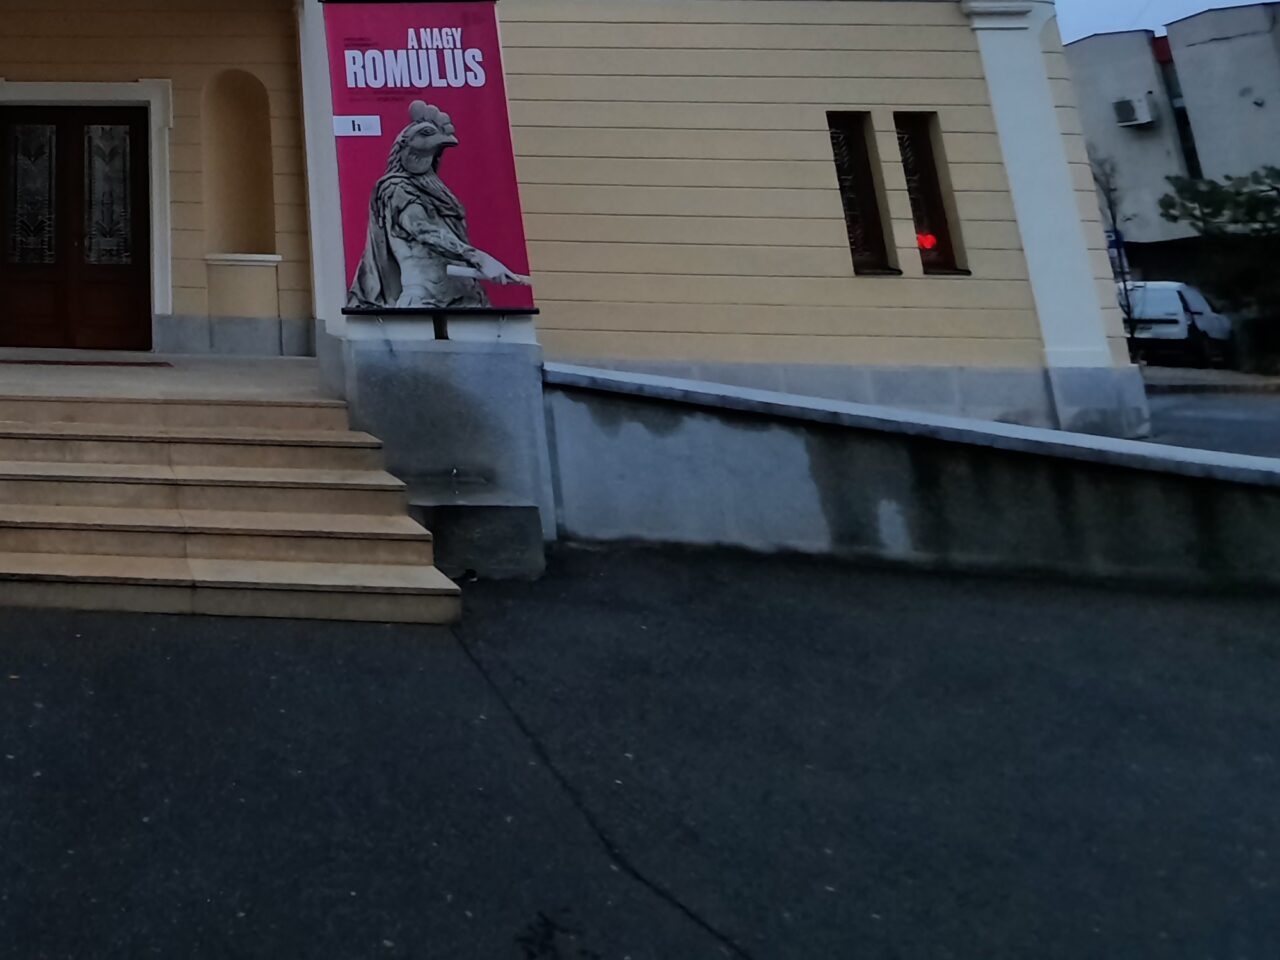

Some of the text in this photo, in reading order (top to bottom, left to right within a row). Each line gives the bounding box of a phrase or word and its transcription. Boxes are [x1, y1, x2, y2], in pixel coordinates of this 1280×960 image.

[407, 27, 462, 49] A NAGY
[344, 48, 486, 88] ROMULUS
